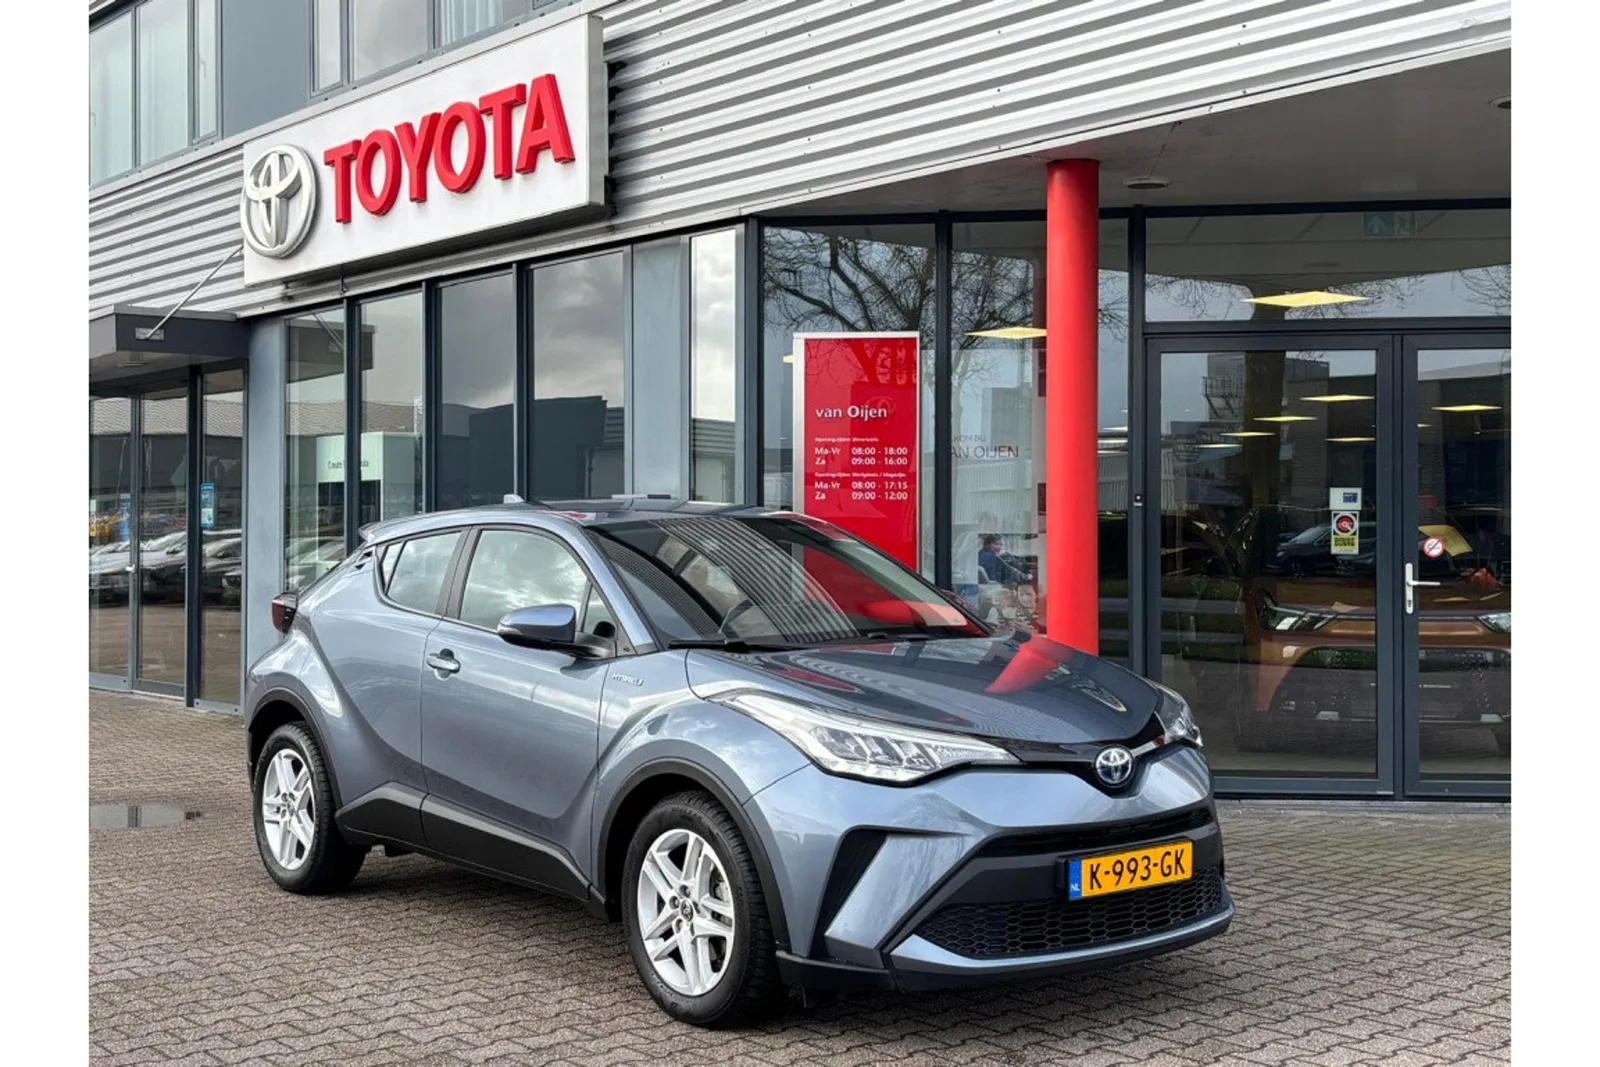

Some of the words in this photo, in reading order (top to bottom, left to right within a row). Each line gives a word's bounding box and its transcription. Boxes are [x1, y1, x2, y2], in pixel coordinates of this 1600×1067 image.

[323, 73, 575, 224] TOYOTA
[815, 407, 843, 418] van
[847, 405, 887, 421] Oijen
[815, 447, 840, 455] Ma-Vr
[851, 447, 876, 455] 08:00
[884, 447, 908, 455] 18:00
[950, 445, 969, 459] AN
[974, 445, 1019, 459] OIJEN
[815, 457, 826, 465] Za
[851, 457, 876, 465] 09:00
[884, 457, 908, 465] 16:00
[815, 481, 840, 489] Ma-Vr
[851, 481, 876, 489] 08:00
[884, 481, 908, 489] 17:15
[815, 492, 826, 500] Za
[851, 492, 876, 500] 09:00
[884, 492, 908, 500] 12:00
[1090, 848, 1185, 890] K-993-GK
[1070, 883, 1080, 892] NL
